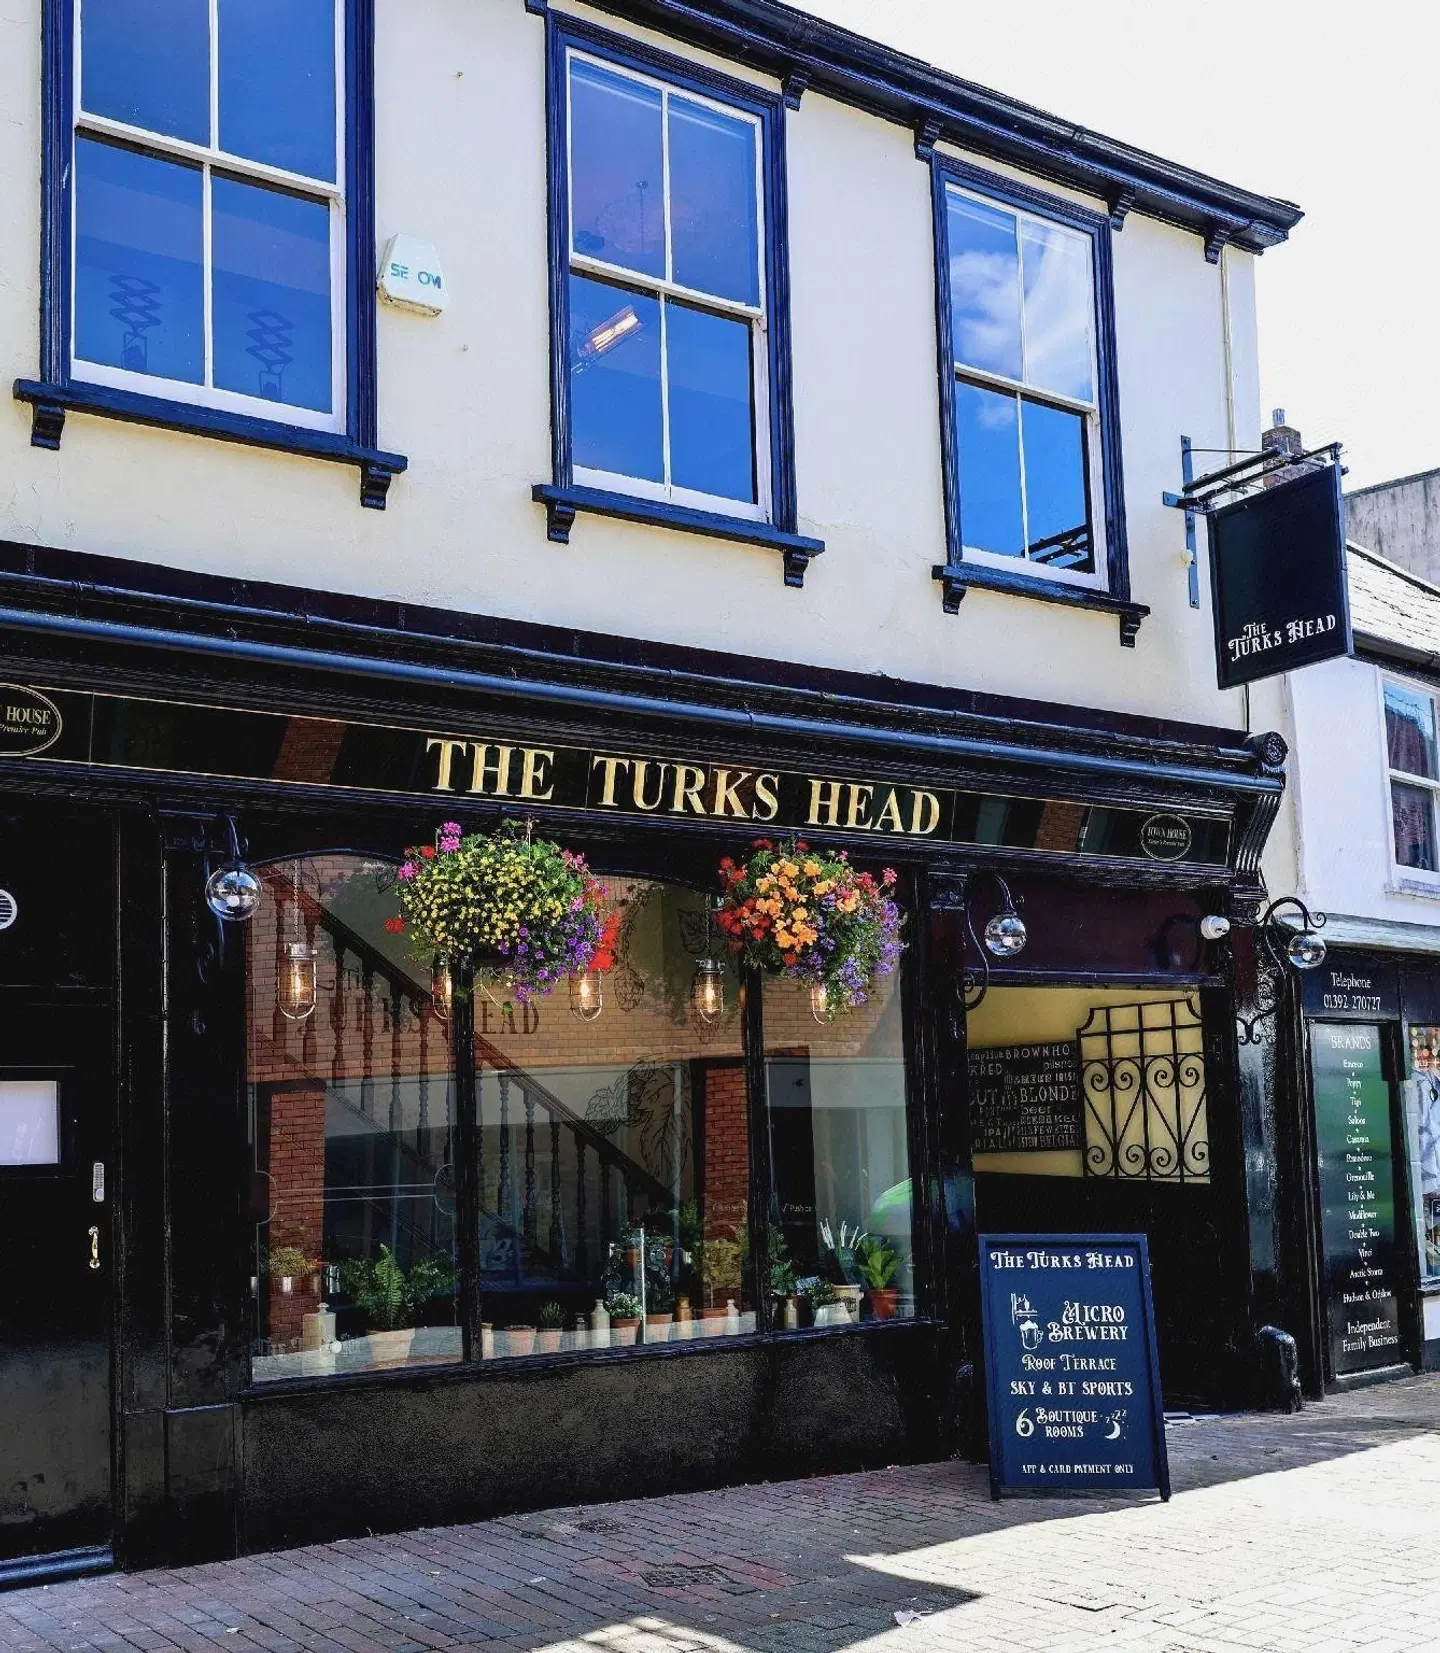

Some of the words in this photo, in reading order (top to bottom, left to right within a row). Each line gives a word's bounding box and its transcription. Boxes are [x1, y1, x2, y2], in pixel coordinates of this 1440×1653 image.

[1227, 630, 1282, 662] TURKS
[1286, 614, 1336, 643] HEAD
[1243, 621, 1267, 639] THE
[6, 706, 51, 725] HOUSE
[31, 726, 47, 736] Pub
[425, 737, 555, 800] THE
[593, 755, 780, 822] TURKS
[805, 778, 940, 836] HEAD
[1330, 971, 1372, 990] Telephone
[1323, 994, 1349, 1009] 01392
[1352, 996, 1381, 1011] 270727
[1331, 1035, 1372, 1050] BRANDS
[1360, 1190, 1366, 1200] &
[990, 1251, 1025, 1269] THE
[1027, 1250, 1082, 1269] TURKS
[1085, 1251, 1134, 1269] HEAD
[1365, 1290, 1371, 1300] &
[1062, 1300, 1125, 1325] MICRO
[1047, 1321, 1128, 1342] BREWERY
[1347, 1317, 1391, 1335] Independent
[1342, 1336, 1367, 1352] Family
[1368, 1334, 1398, 1348] Business
[1022, 1354, 1056, 1371] ROOF
[1060, 1354, 1117, 1371] TERRACE
[1010, 1380, 1036, 1395] SKY
[1042, 1380, 1053, 1395] &
[1058, 1381, 1076, 1395] BT
[1082, 1381, 1134, 1396] SPORTS
[1015, 1407, 1035, 1437] 6
[1035, 1407, 1098, 1424] BOUTIQUE
[1045, 1425, 1084, 1438] ROOMS
[1039, 1464, 1046, 1474] &
[1048, 1464, 1071, 1474] CARD
[1074, 1464, 1112, 1474] PAYMENT
[1114, 1464, 1134, 1474] ONLY
